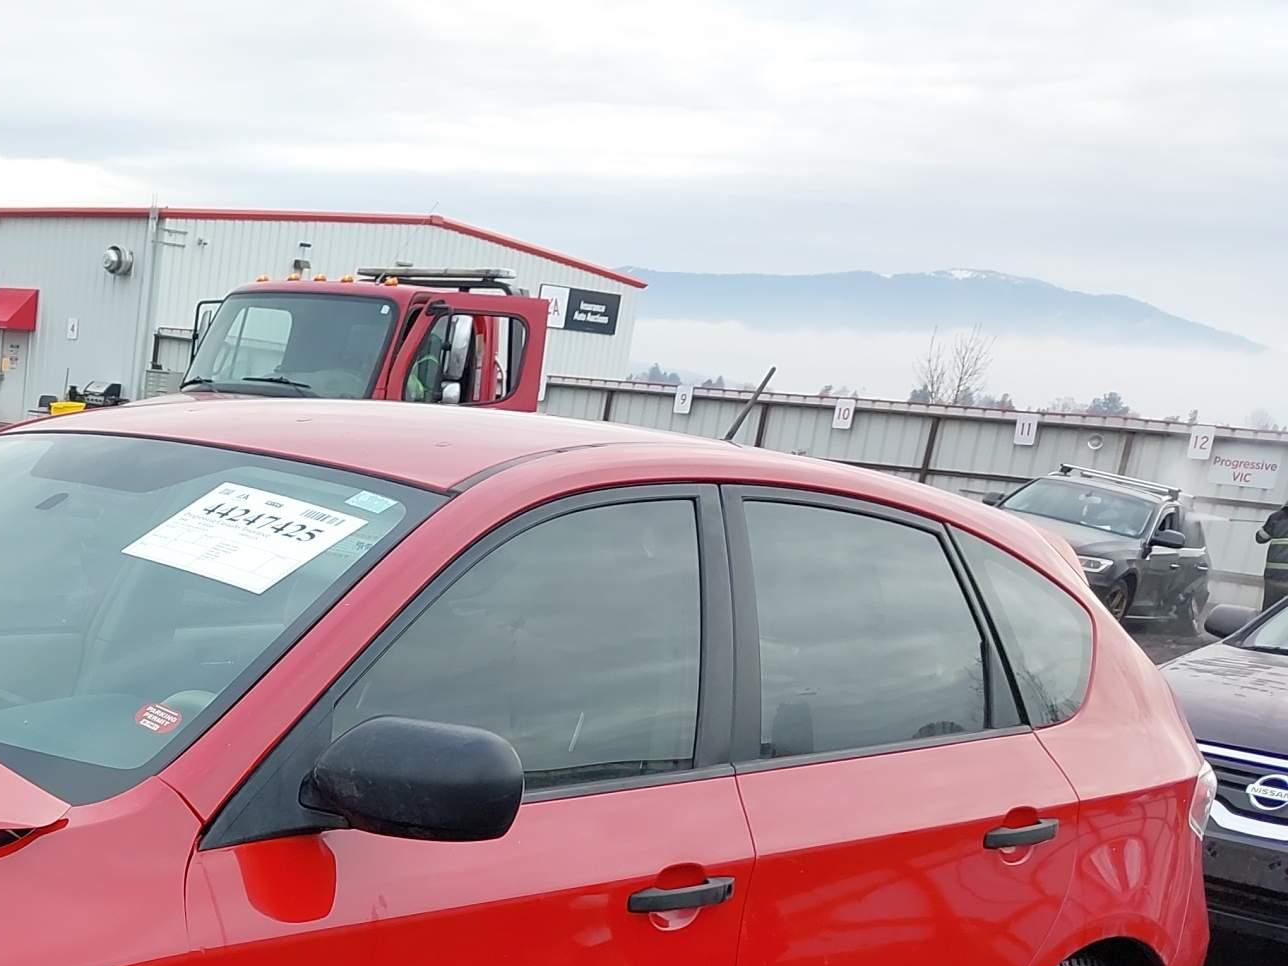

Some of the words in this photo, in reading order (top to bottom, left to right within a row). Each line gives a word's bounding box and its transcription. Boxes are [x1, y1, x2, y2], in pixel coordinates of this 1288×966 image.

[680, 393, 688, 405] 9
[837, 407, 850, 421] 10
[1020, 422, 1031, 437] 11
[1193, 435, 1210, 450] 12
[1213, 456, 1278, 472] Progressive
[1232, 471, 1253, 483] VIC
[203, 503, 324, 542] 44247425
